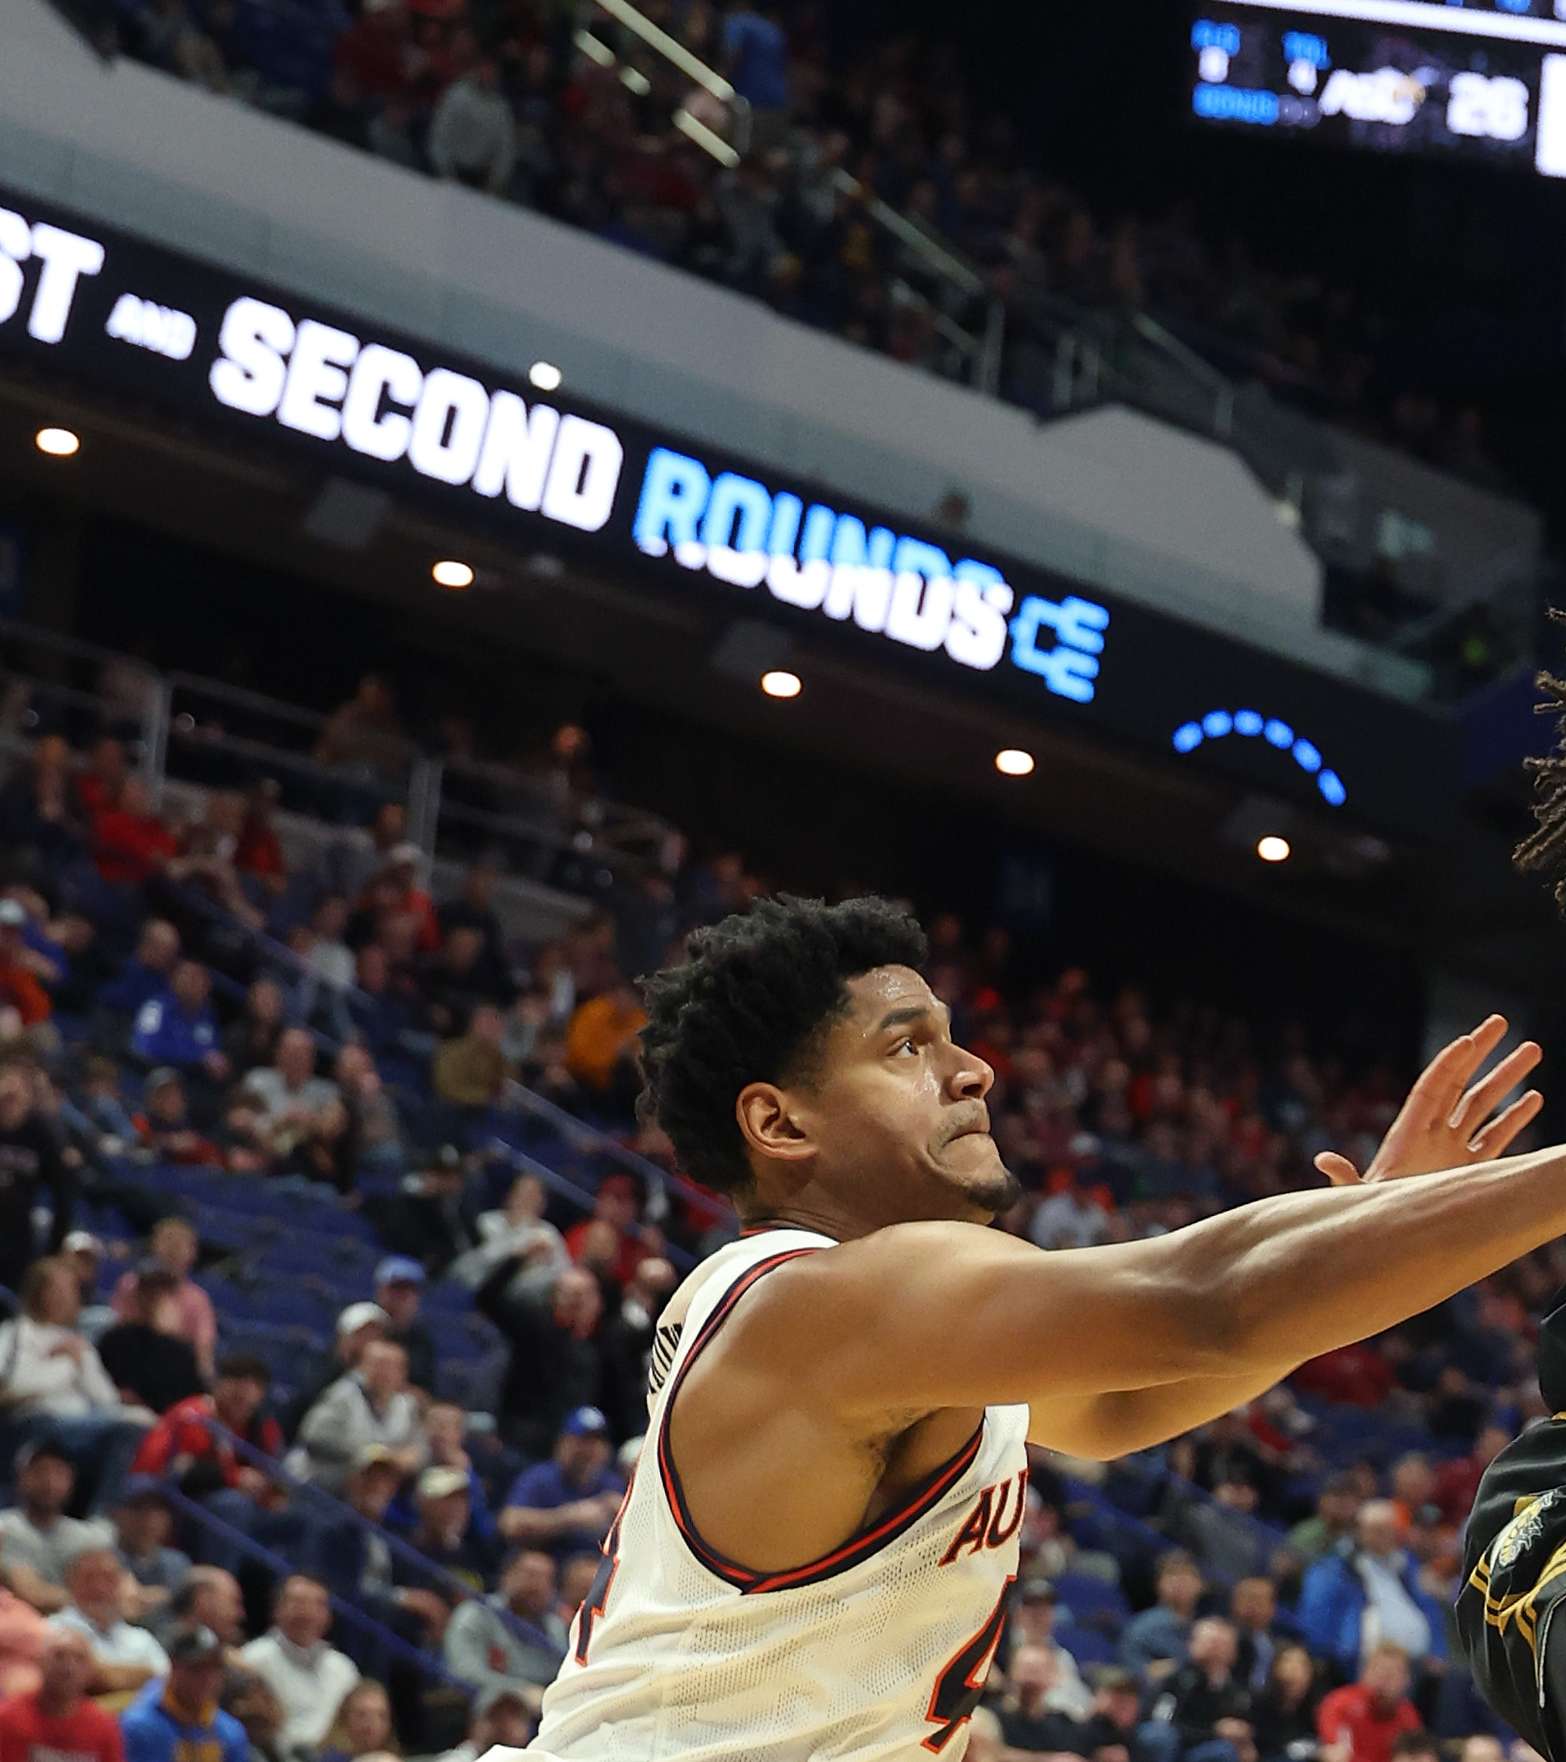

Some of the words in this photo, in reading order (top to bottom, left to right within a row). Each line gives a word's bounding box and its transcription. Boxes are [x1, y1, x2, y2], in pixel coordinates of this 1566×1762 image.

[106, 291, 197, 360] AND
[209, 296, 624, 532] SECOND
[632, 446, 1014, 670] ROUNDS
[937, 1469, 1029, 1568] AU
